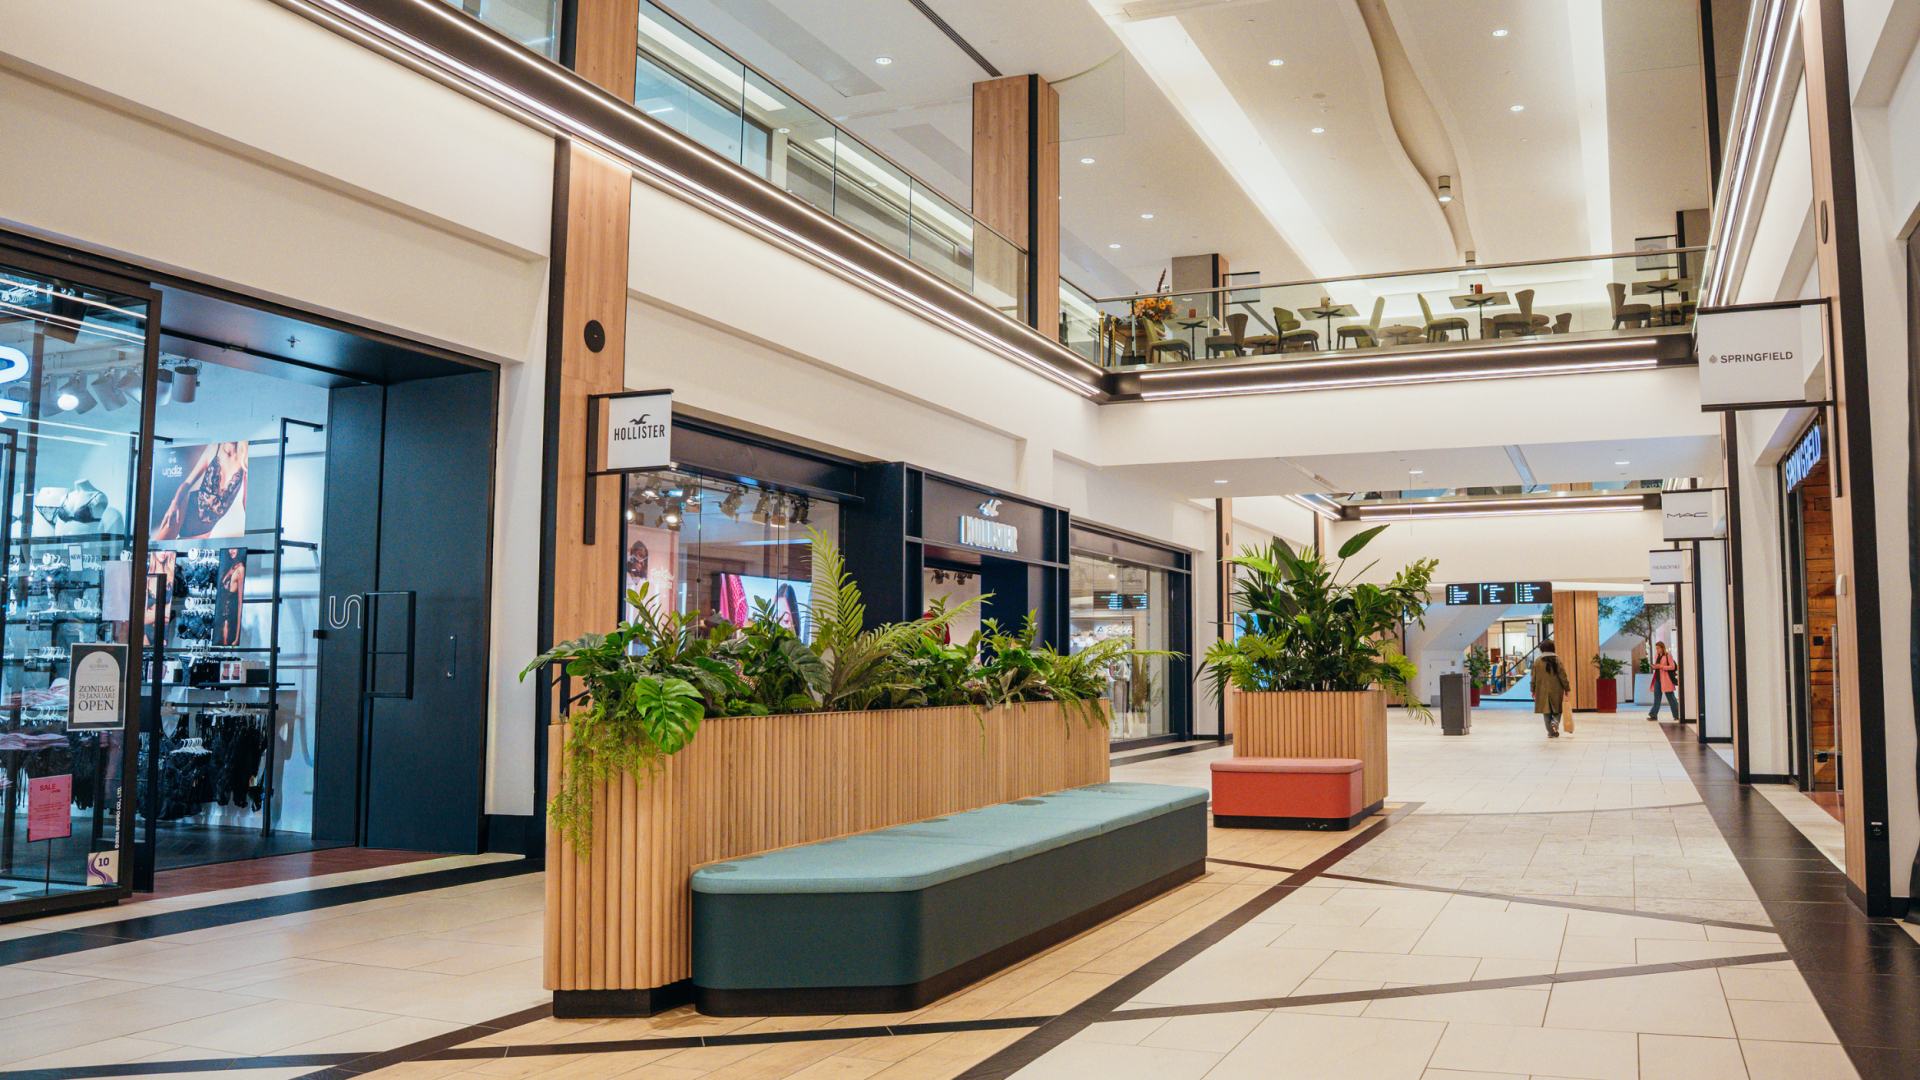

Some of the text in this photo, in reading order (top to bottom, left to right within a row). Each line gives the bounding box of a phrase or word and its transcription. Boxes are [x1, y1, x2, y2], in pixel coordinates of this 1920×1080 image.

[1720, 351, 1793, 364] SPRINGFIELD
[614, 424, 665, 441] HOLLISTER
[1785, 424, 1821, 493] SPRINGFIELD
[162, 465, 183, 476] undiz
[1667, 511, 1708, 519] MAC
[960, 515, 1018, 553] HOLLISTER
[79, 685, 115, 693] ZONDAG
[86, 692, 115, 700] JANUARI
[78, 700, 114, 711] OPEN
[39, 783, 56, 792] SALE
[98, 857, 110, 867] 10
